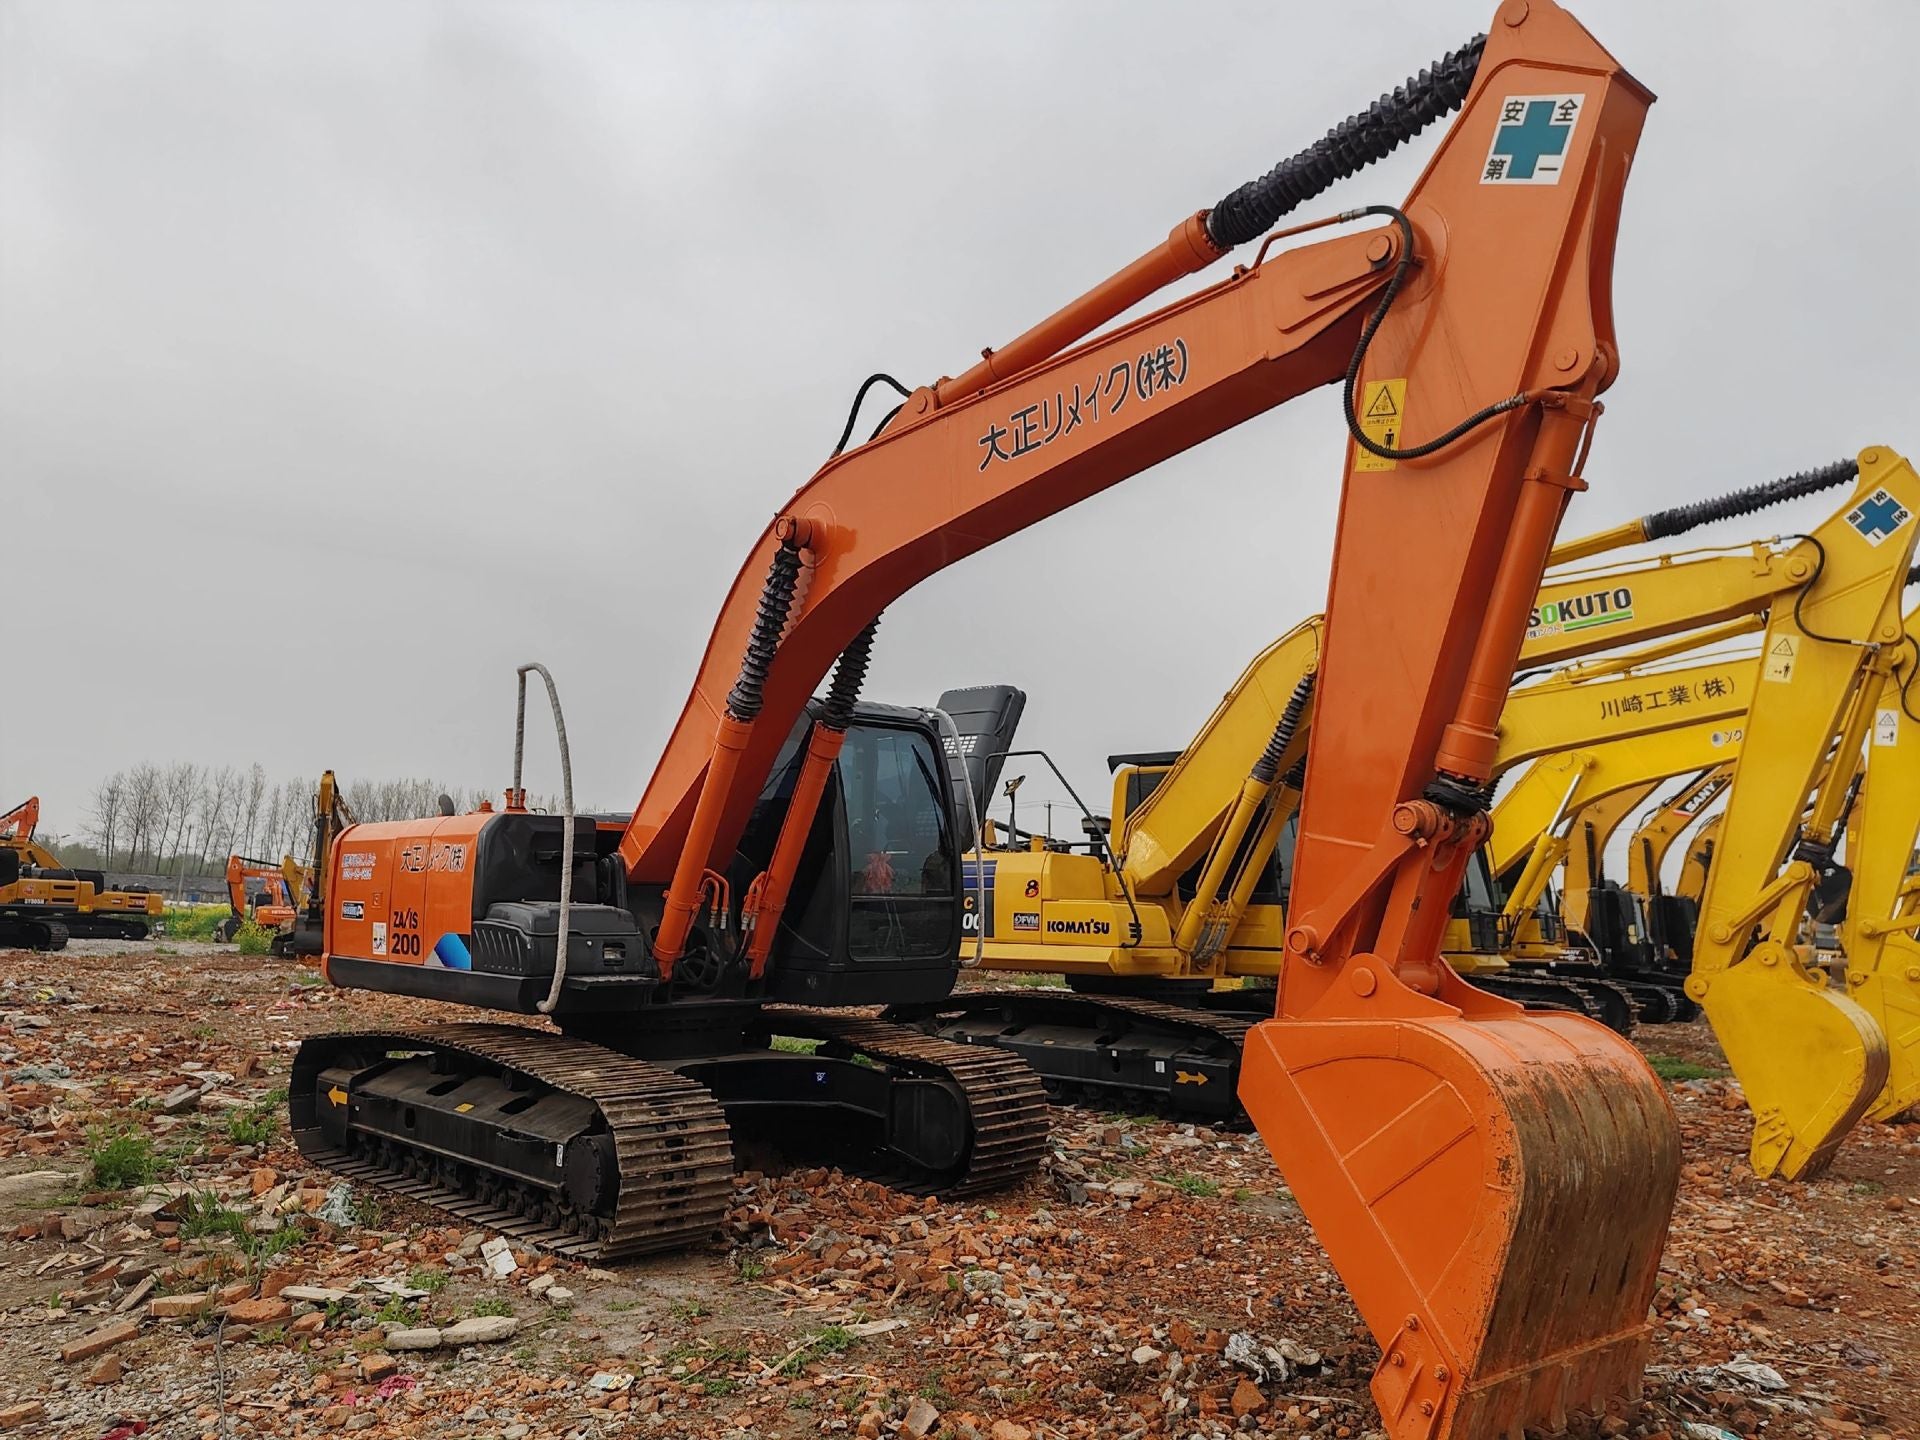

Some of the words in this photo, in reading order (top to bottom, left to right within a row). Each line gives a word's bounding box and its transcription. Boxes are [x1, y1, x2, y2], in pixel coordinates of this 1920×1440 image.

[979, 337, 1188, 472] 大正リメイク(株)
[1528, 588, 1632, 628] SOKUTO
[1600, 676, 1736, 720] 川崎工業(株)
[1684, 780, 1719, 813] SANY
[1047, 918, 1110, 934] KOMATSU
[391, 933, 420, 956] 200
